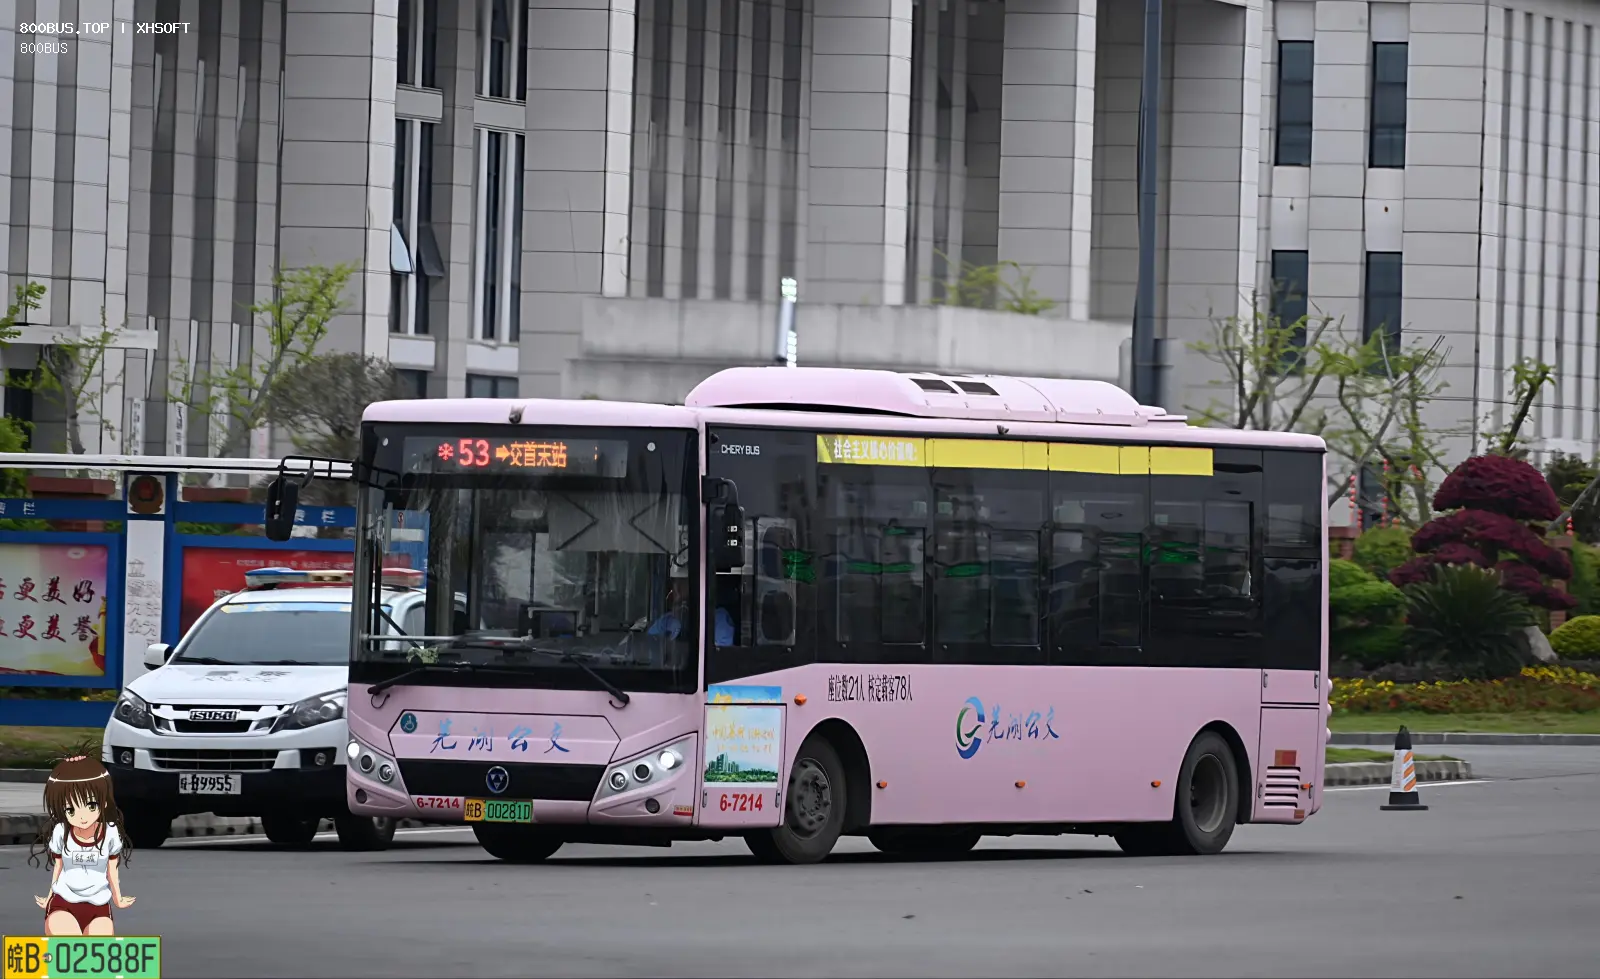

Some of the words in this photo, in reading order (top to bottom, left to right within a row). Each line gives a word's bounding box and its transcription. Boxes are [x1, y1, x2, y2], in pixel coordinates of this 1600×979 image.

[459, 438, 490, 466] 53
[510, 440, 567, 468] 交首末站
[720, 443, 744, 455] CHERY
[745, 444, 761, 456] BUS
[430, 718, 570, 754] 芜湖公交
[987, 703, 1059, 744] 芜湖公交
[416, 797, 460, 809] 6-7214
[720, 793, 762, 811] 6-7214
